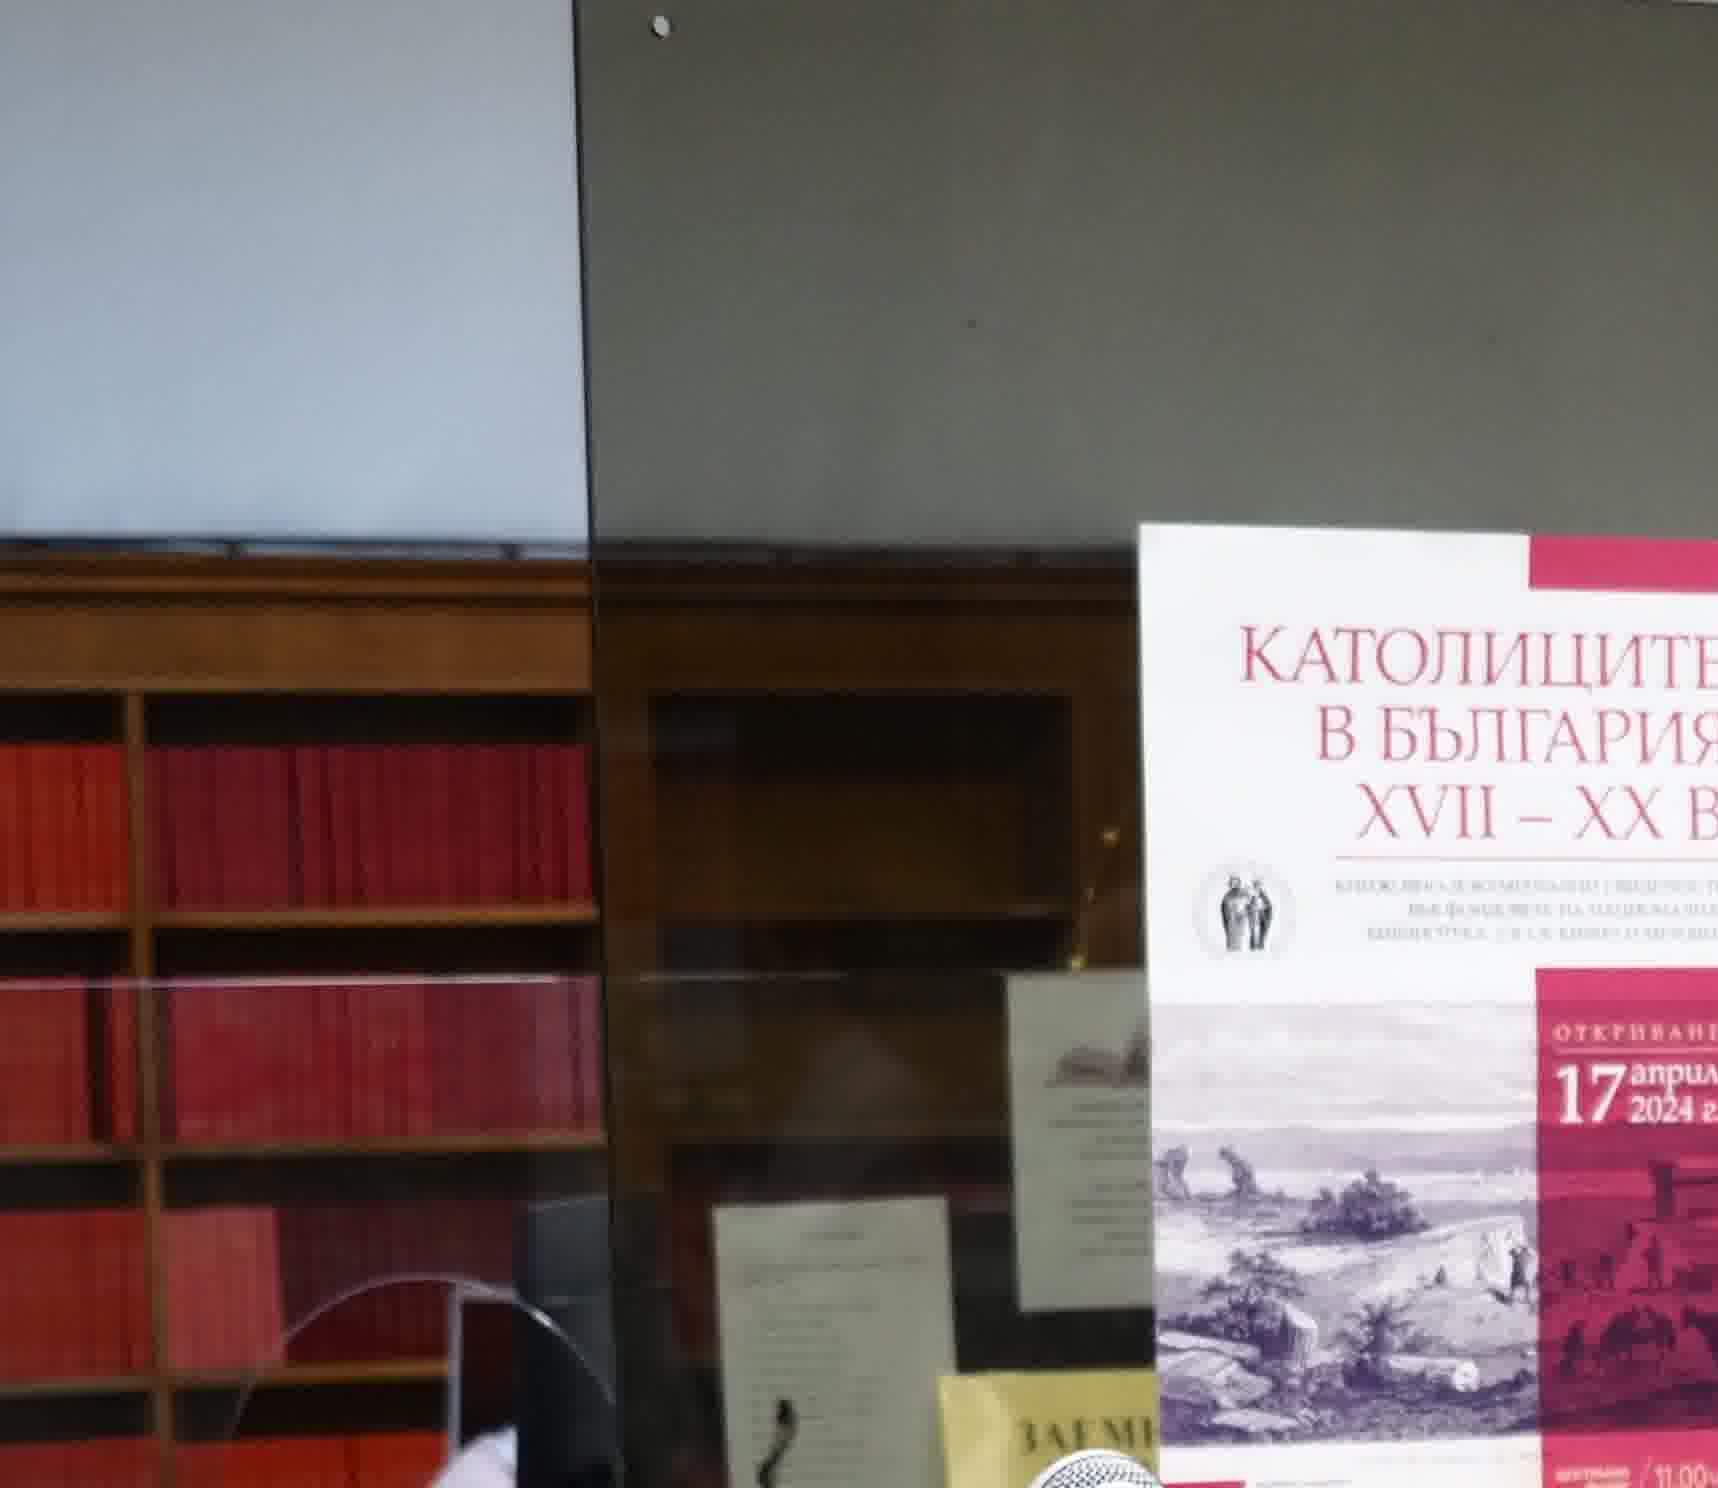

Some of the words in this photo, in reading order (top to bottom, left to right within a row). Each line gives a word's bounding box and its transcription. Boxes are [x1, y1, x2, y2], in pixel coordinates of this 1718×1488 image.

[1317, 704, 1356, 761] В
[1356, 782, 1497, 840] XVII
[1574, 785, 1665, 842] XX
[1554, 1063, 1627, 1125] 17
[1628, 1094, 1695, 1125] 2024
